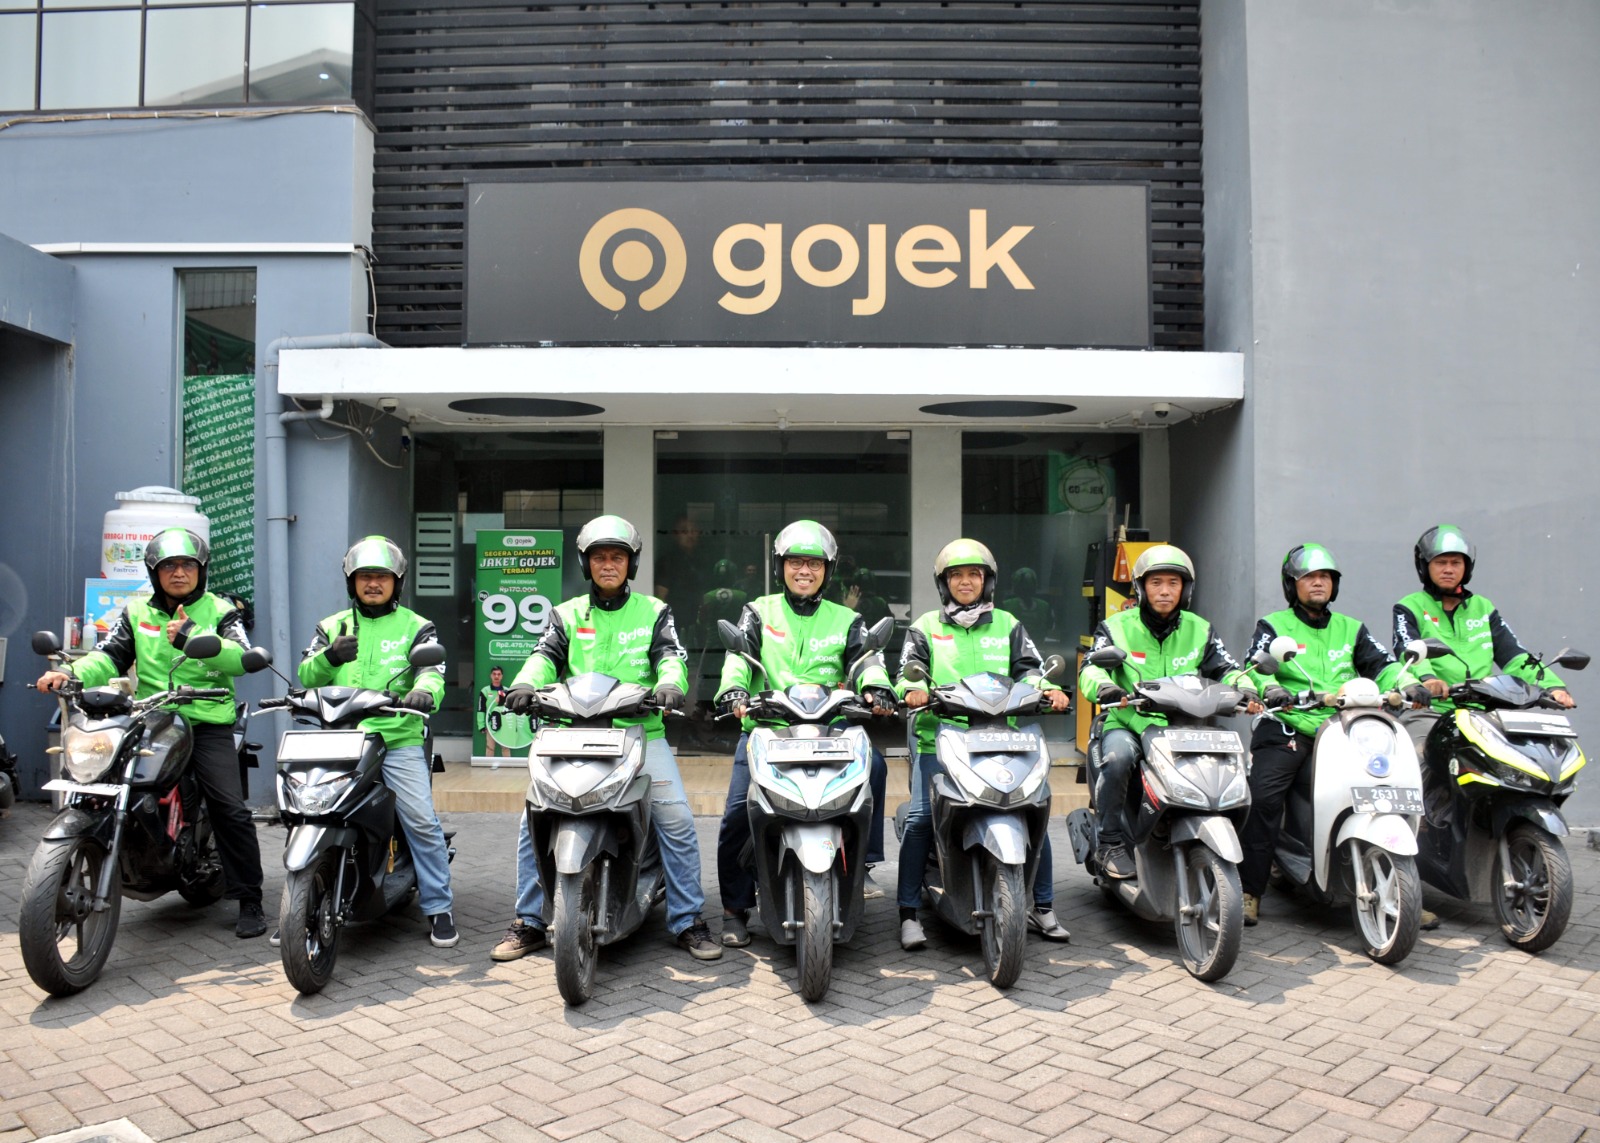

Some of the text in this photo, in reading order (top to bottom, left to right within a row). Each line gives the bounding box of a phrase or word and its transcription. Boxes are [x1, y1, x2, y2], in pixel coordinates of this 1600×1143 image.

[712, 208, 1035, 315] gojek
[513, 549, 554, 557] DAPATKAN!
[480, 557, 556, 567] JAKET GOJEK
[482, 594, 552, 634] 99
[1354, 789, 1362, 799] L
[1371, 789, 1399, 800] 2631
